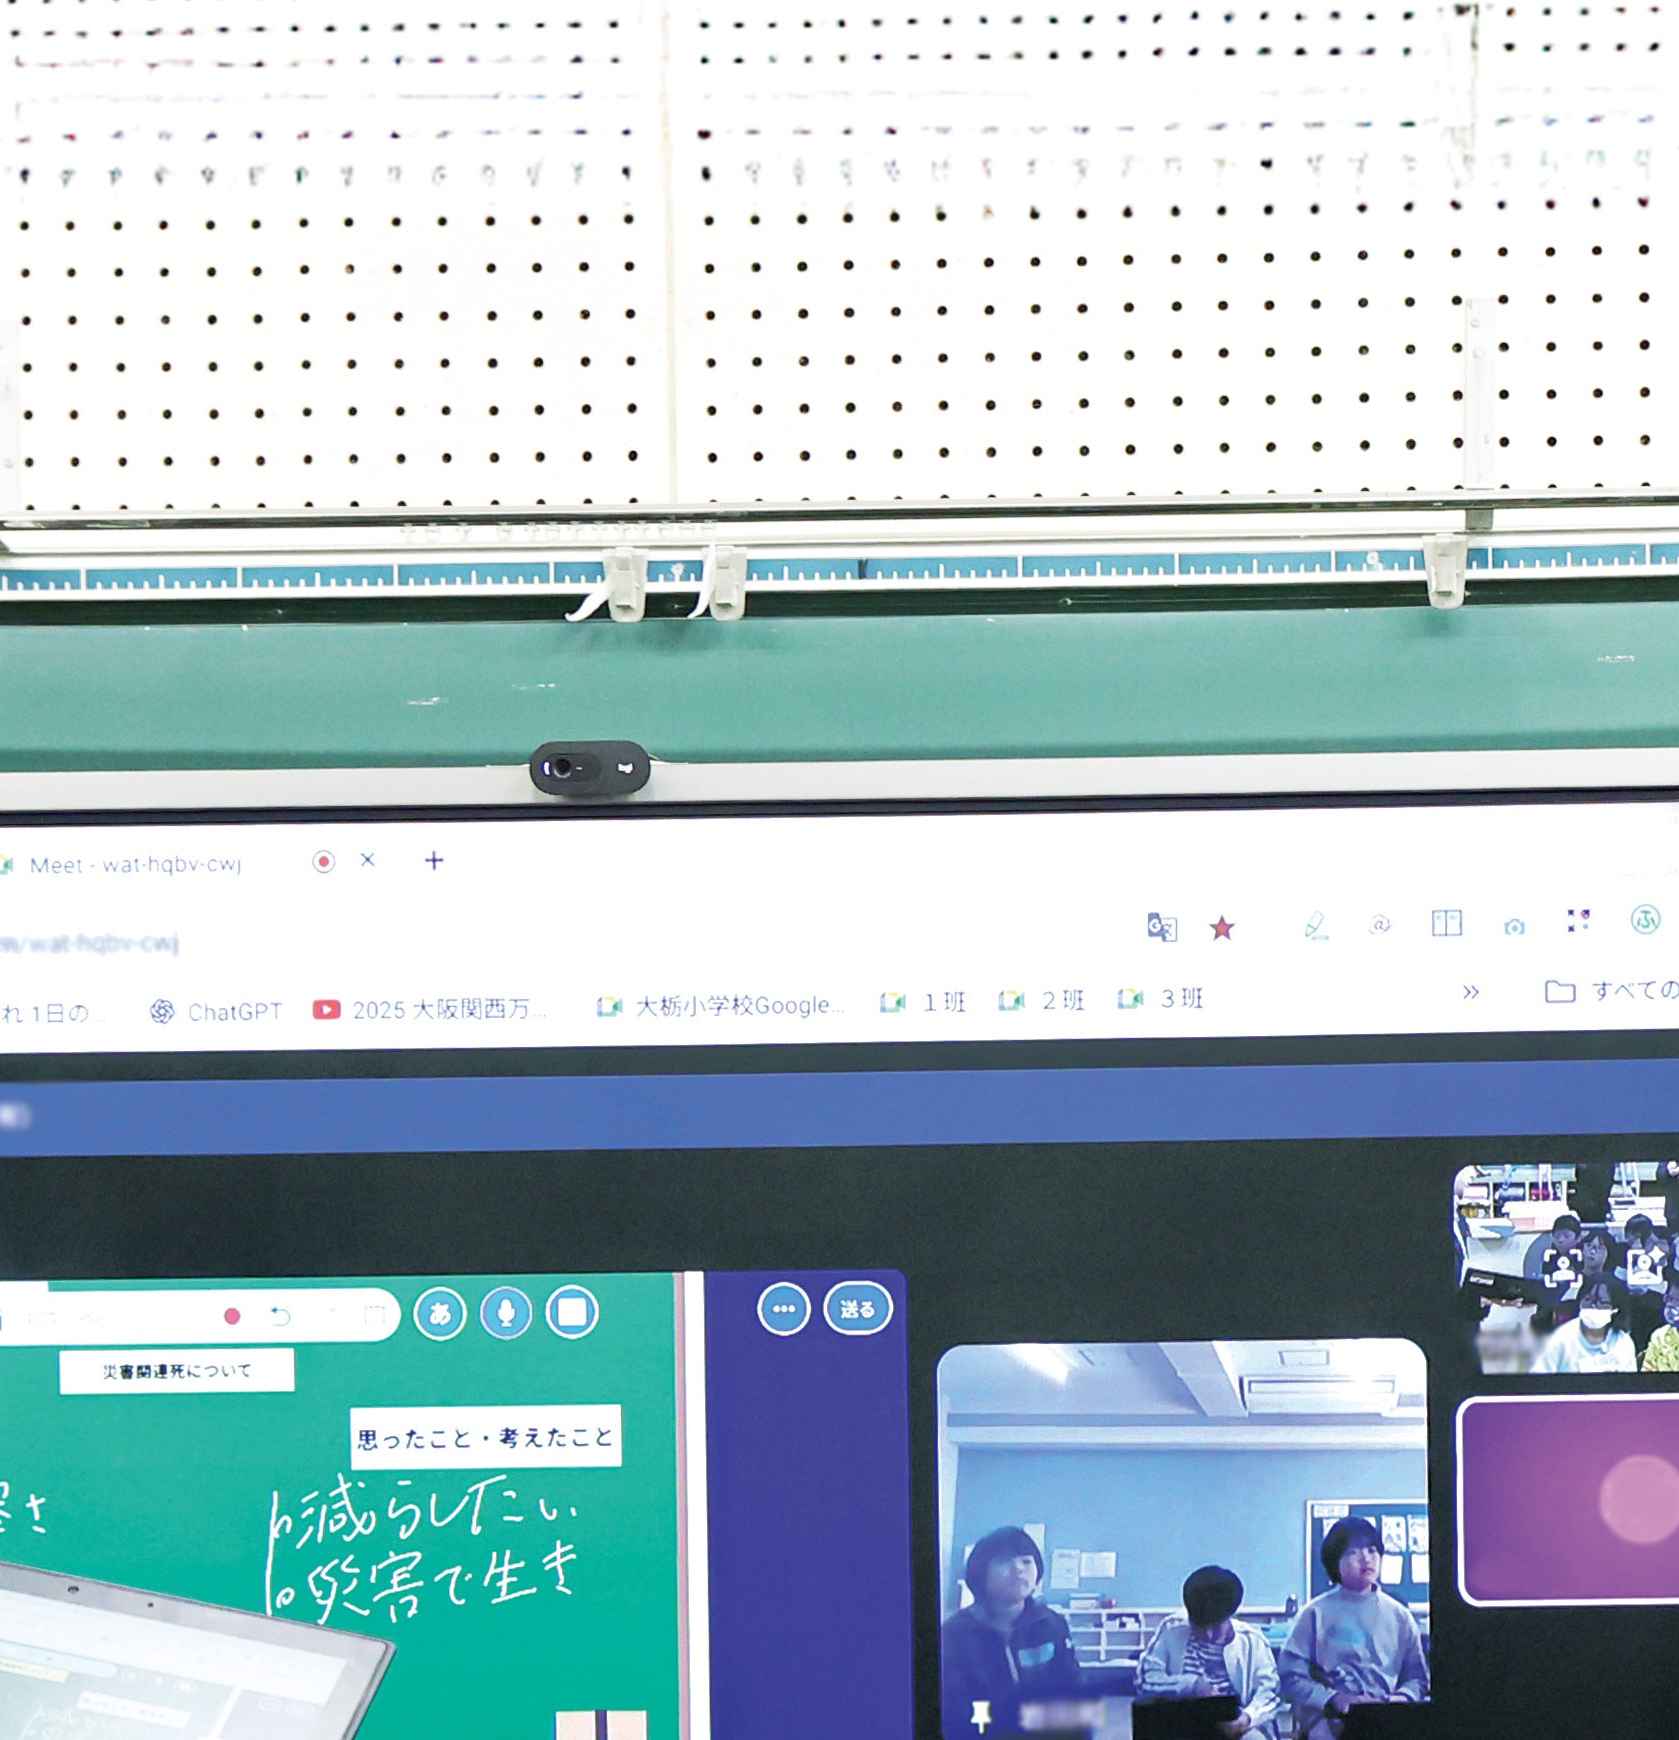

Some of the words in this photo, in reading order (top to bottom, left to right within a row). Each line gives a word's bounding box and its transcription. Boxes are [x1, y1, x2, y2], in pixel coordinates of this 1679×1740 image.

[29, 858, 84, 875] Meet
[188, 1002, 283, 1022] ChatGPT
[352, 1000, 406, 1020] 2025
[840, 1299, 876, 1320] 送る
[356, 1426, 613, 1451] 思ったこと・考えたこと
